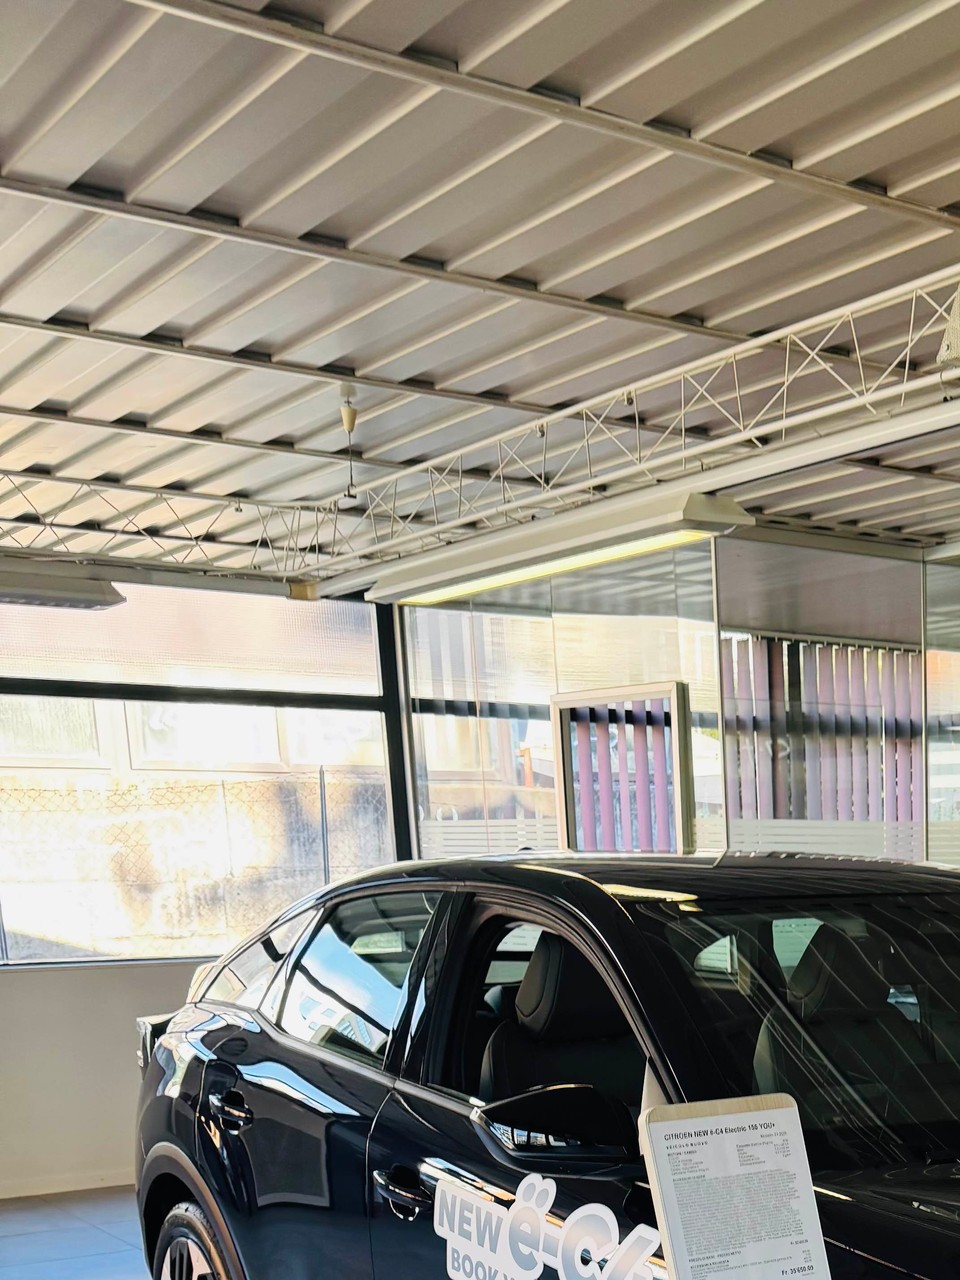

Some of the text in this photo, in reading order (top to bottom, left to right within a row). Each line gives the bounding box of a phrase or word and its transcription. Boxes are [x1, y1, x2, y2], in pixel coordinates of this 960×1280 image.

[694, 1128, 709, 1138] NEW
[724, 1125, 747, 1135] Electric
[438, 1189, 504, 1254] NEW
